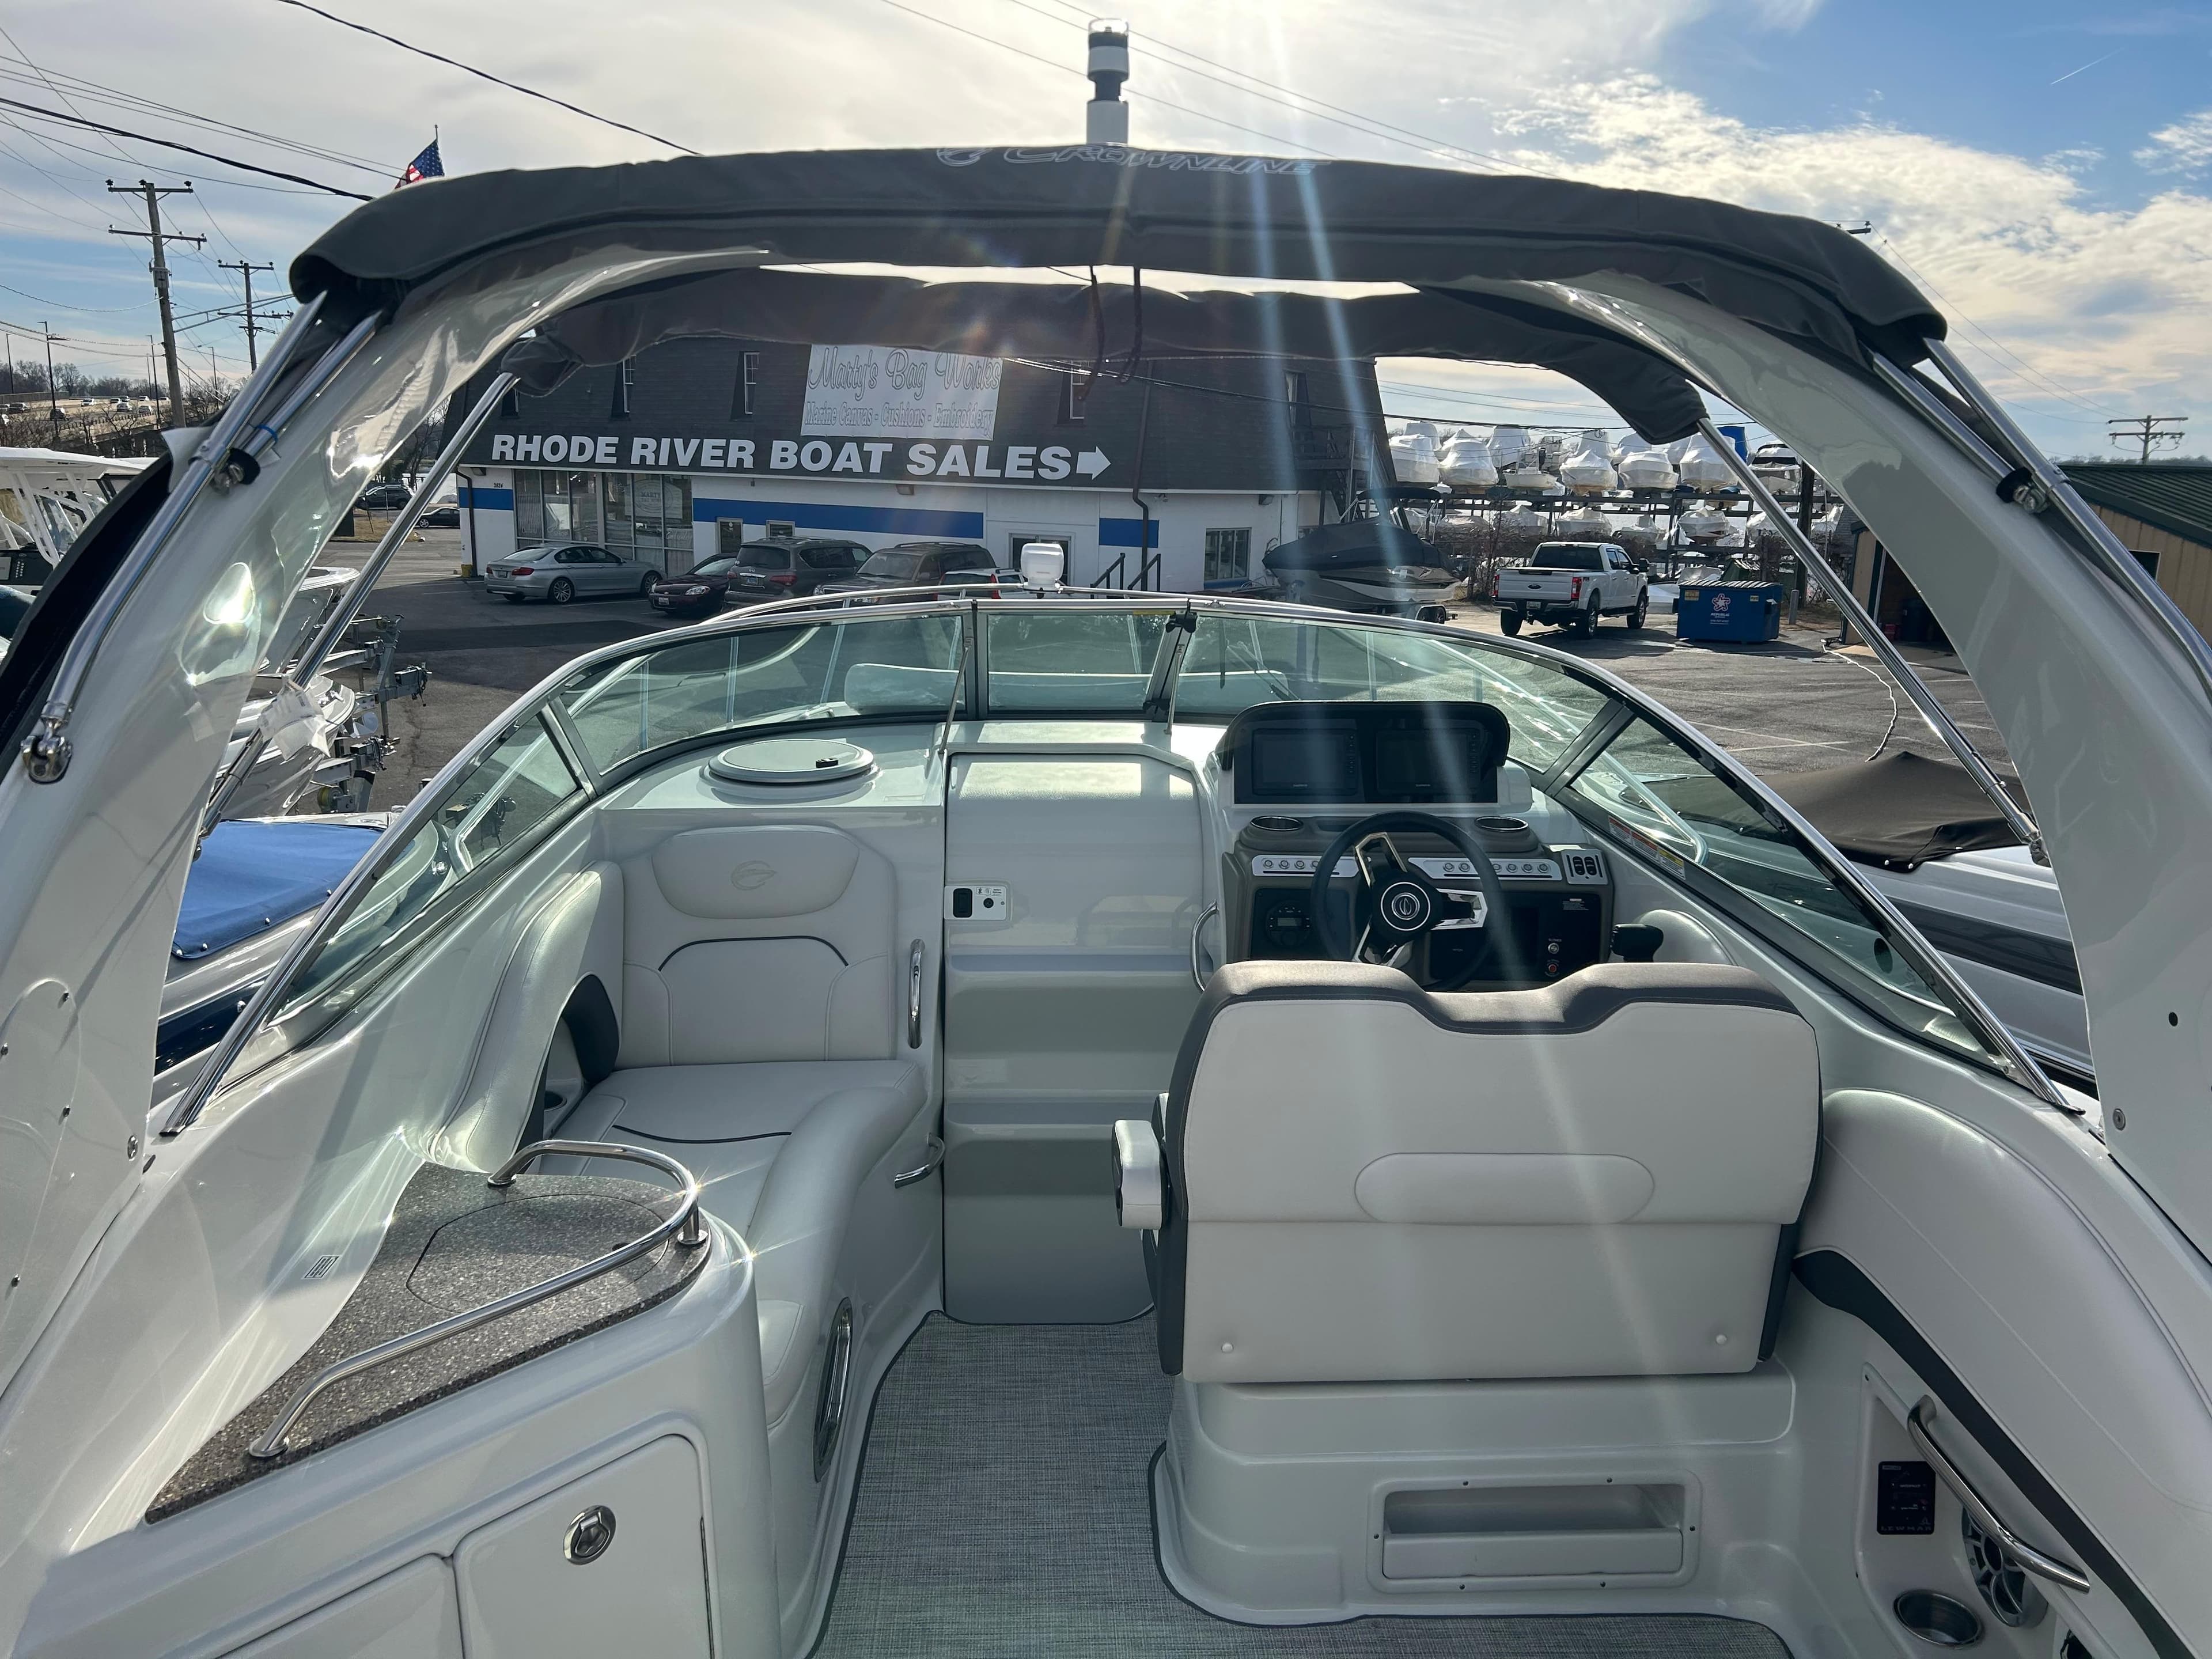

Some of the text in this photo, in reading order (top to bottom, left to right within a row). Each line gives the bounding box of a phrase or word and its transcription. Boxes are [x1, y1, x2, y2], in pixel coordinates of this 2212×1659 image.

[1003, 145, 1331, 175] CROWNLINE
[808, 346, 878, 402] Marty's
[885, 348, 928, 401] Bag
[804, 401, 837, 426] Marine
[839, 402, 873, 427] Canvas
[881, 402, 926, 427] Cushions
[933, 402, 994, 436] Embroidery
[491, 434, 1071, 480] RHODE RIVER BOAT SALES
